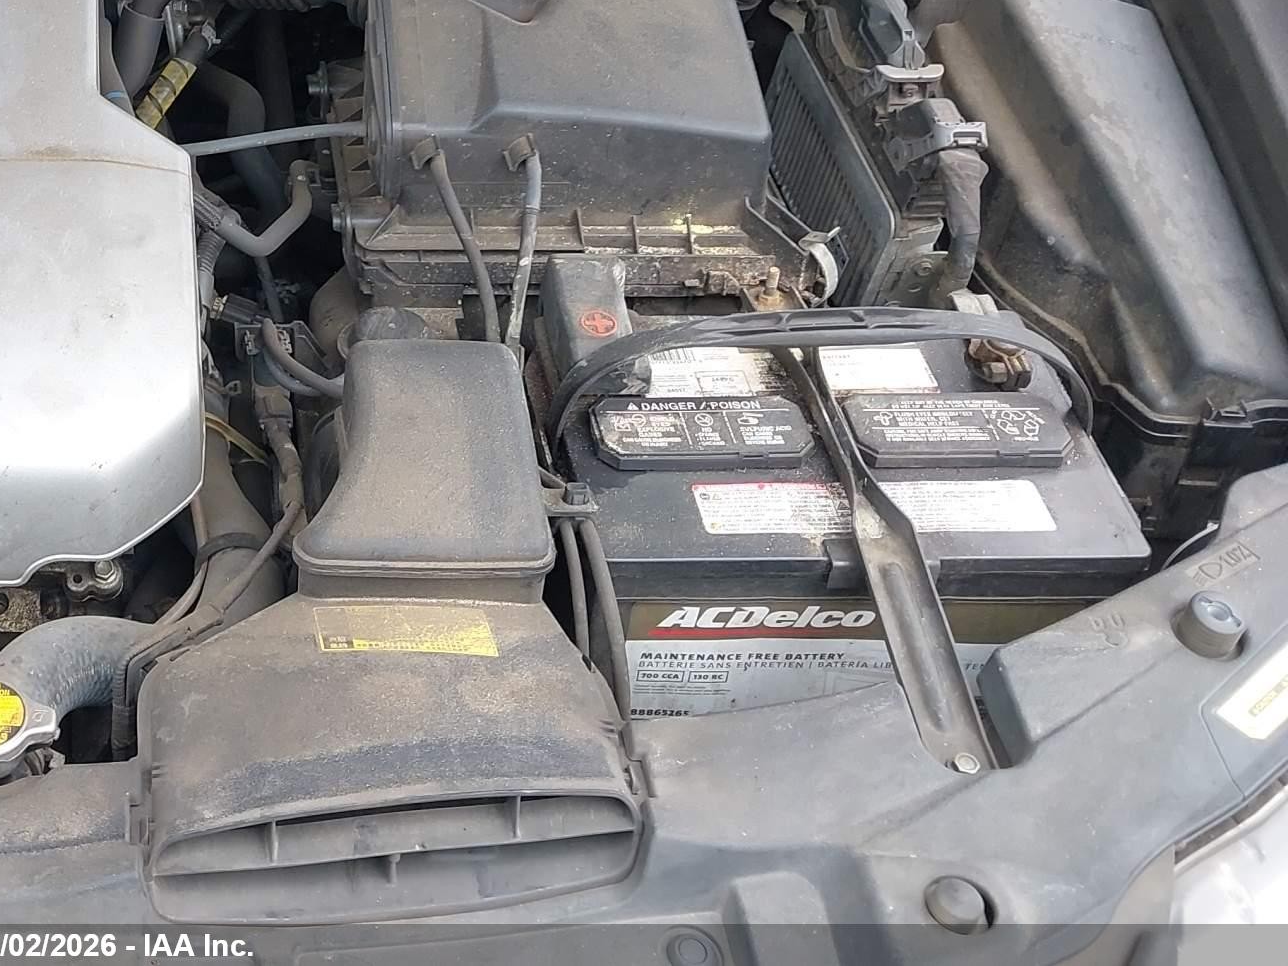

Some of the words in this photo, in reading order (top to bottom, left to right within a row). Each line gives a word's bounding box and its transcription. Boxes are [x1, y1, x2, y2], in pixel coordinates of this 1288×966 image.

[641, 401, 696, 411] DANGER
[709, 400, 761, 410] POISON
[656, 605, 877, 629] ACDelco
[640, 652, 742, 661] MAINTENANCE
[748, 652, 781, 661] FREE
[785, 652, 845, 661] BATTERY
[638, 661, 696, 669] BATTERIE
[699, 661, 732, 669] SANS
[736, 661, 805, 670] ENTRETIEN
[874, 661, 893, 669] LIB
[639, 672, 660, 680] 700
[661, 672, 680, 680] CCA
[693, 673, 710, 681] 130
[711, 673, 724, 681] RC
